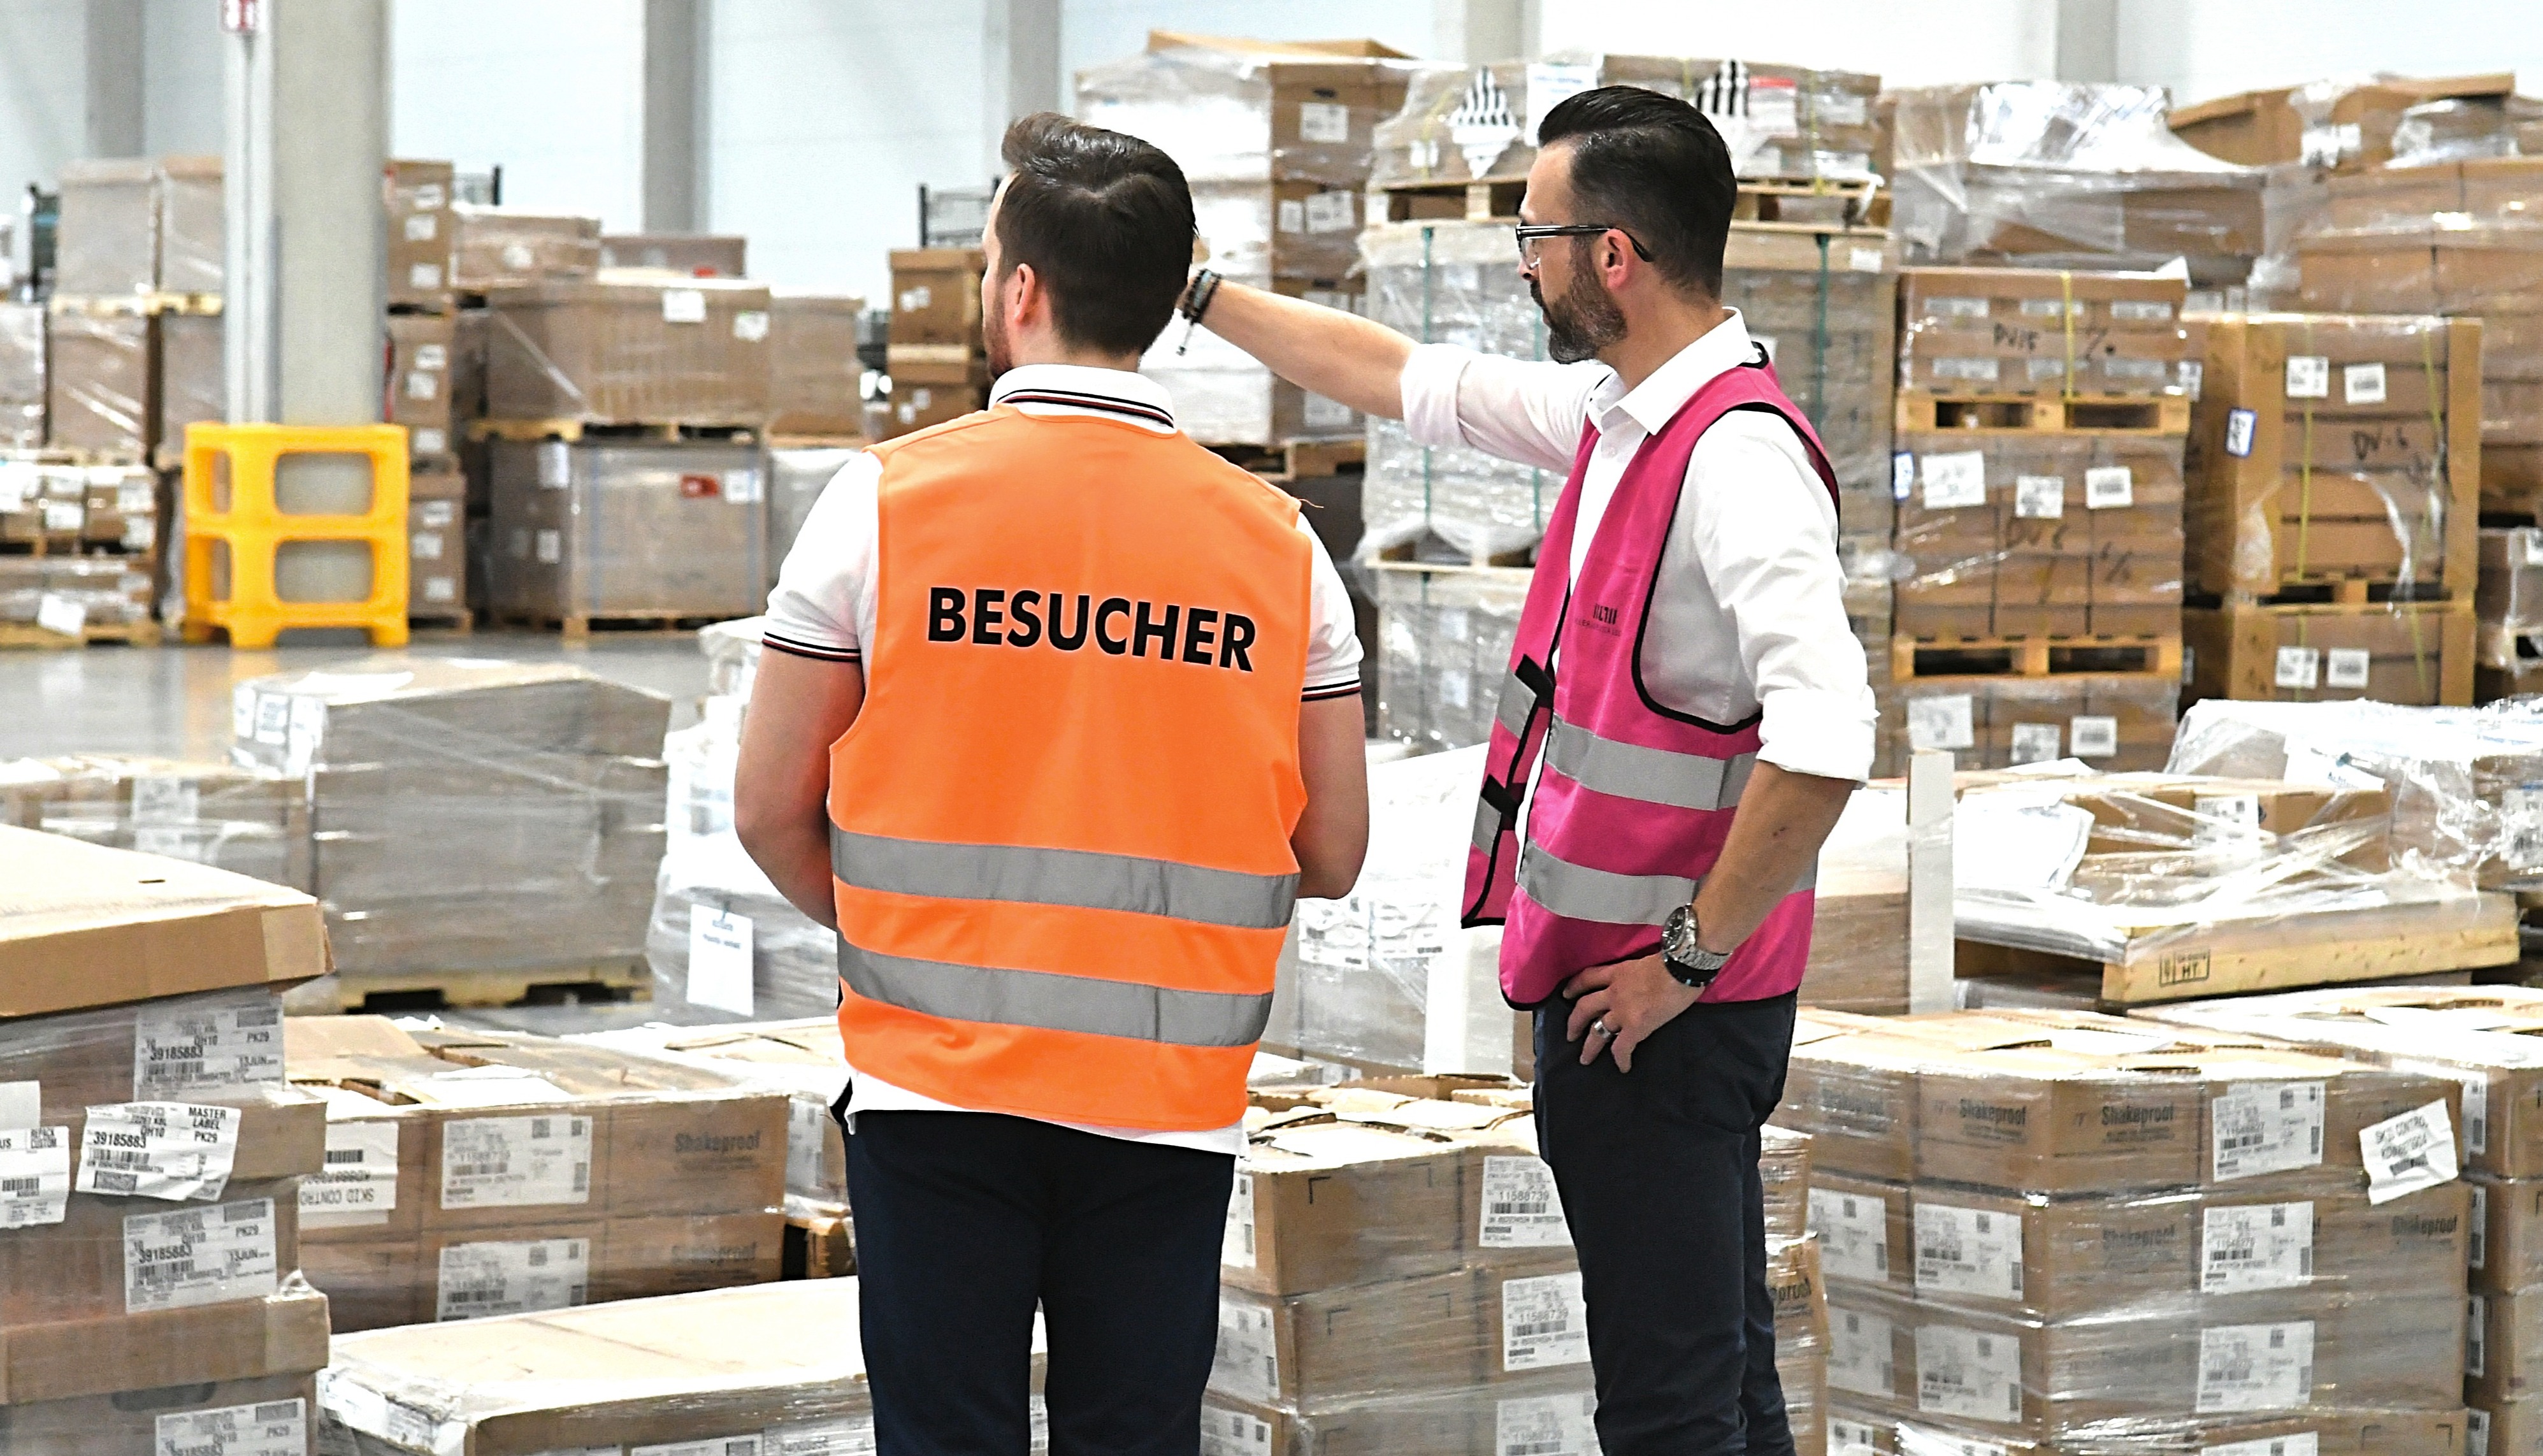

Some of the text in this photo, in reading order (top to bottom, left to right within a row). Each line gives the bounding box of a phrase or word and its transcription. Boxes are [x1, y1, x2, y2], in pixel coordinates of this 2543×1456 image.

[928, 587, 1255, 672] BESUCHER
[150, 1044, 203, 1061] 39185883
[189, 1107, 226, 1120] MASTER
[1960, 1098, 2027, 1126] Shakeproof
[2101, 1102, 2174, 1127] Shakeproof
[193, 1119, 220, 1130] LABEL
[93, 1130, 147, 1148] 39185883
[194, 1131, 217, 1143] PK29
[674, 1129, 761, 1154] Shakeproof
[138, 1242, 193, 1264] 39185883
